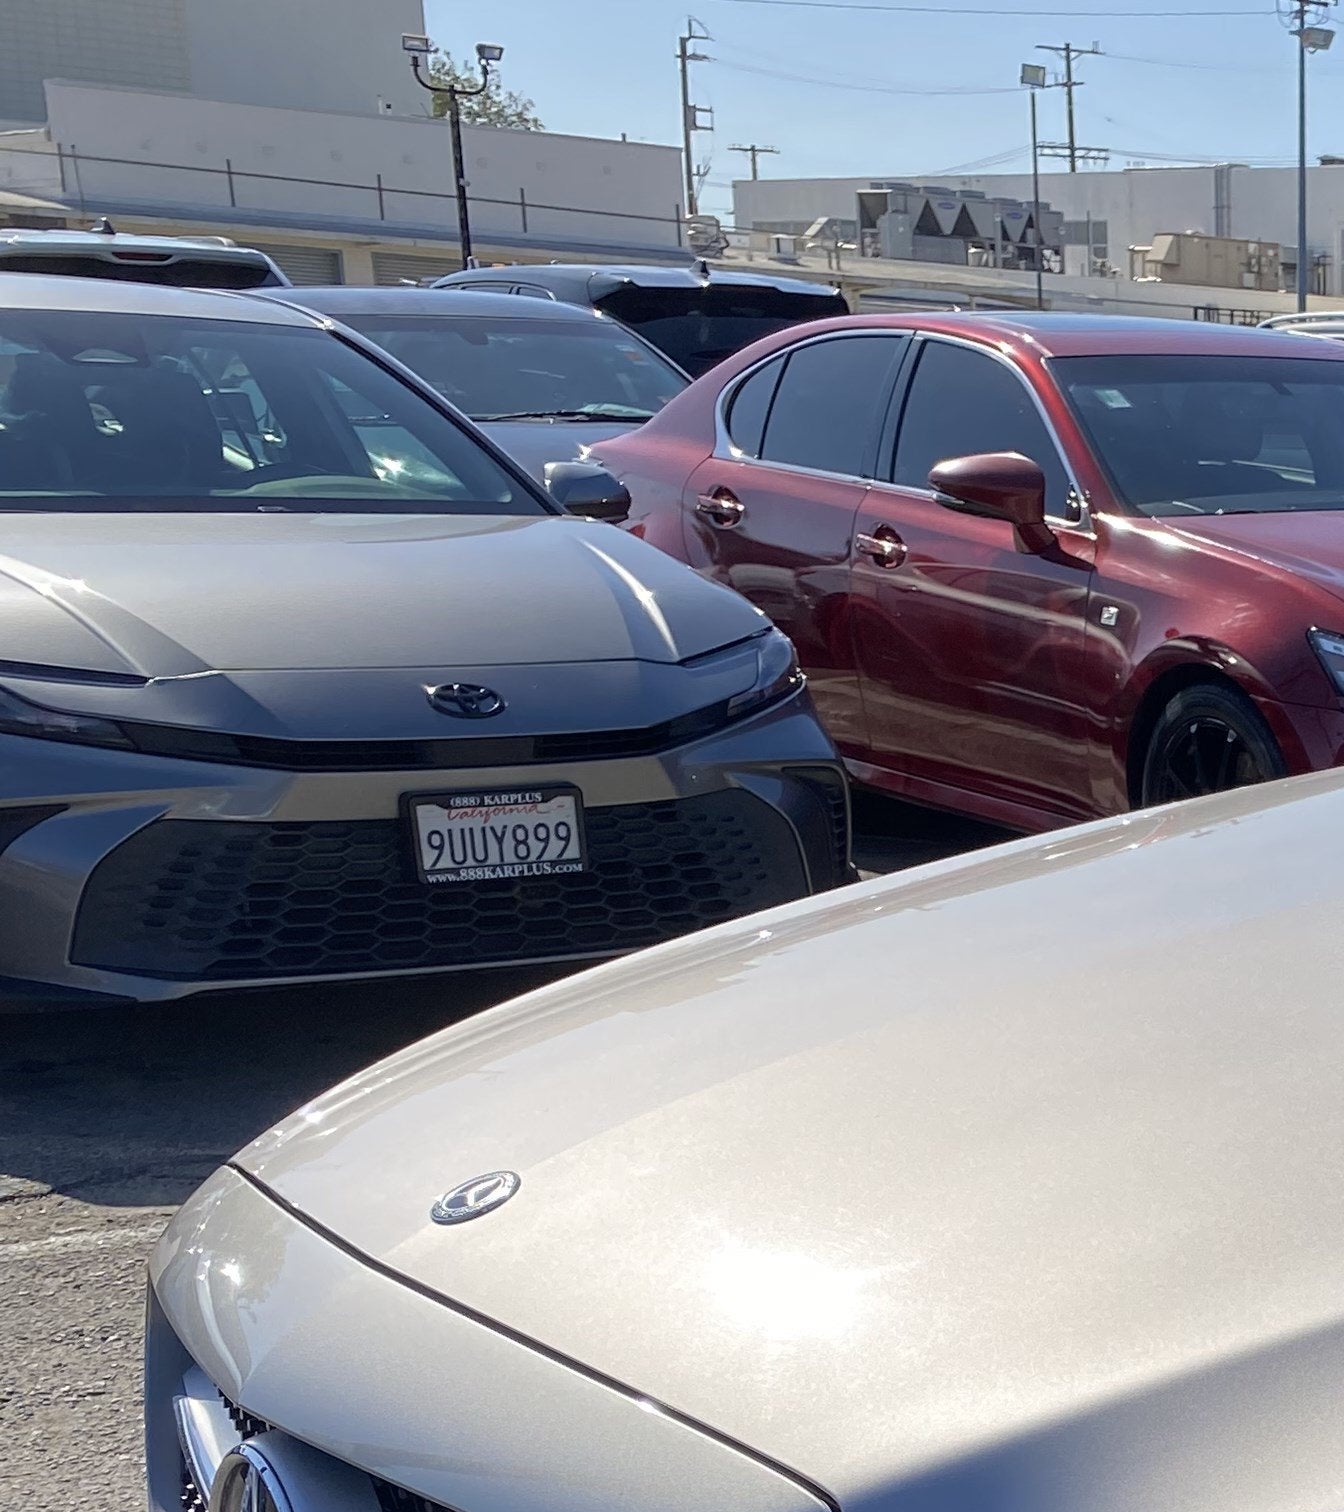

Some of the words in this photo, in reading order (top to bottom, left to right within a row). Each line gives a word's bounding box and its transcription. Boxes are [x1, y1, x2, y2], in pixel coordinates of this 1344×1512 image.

[450, 796, 479, 808] (888)
[484, 792, 542, 806] KARPLUS
[447, 803, 550, 824] California
[427, 821, 571, 869] 9UUY899
